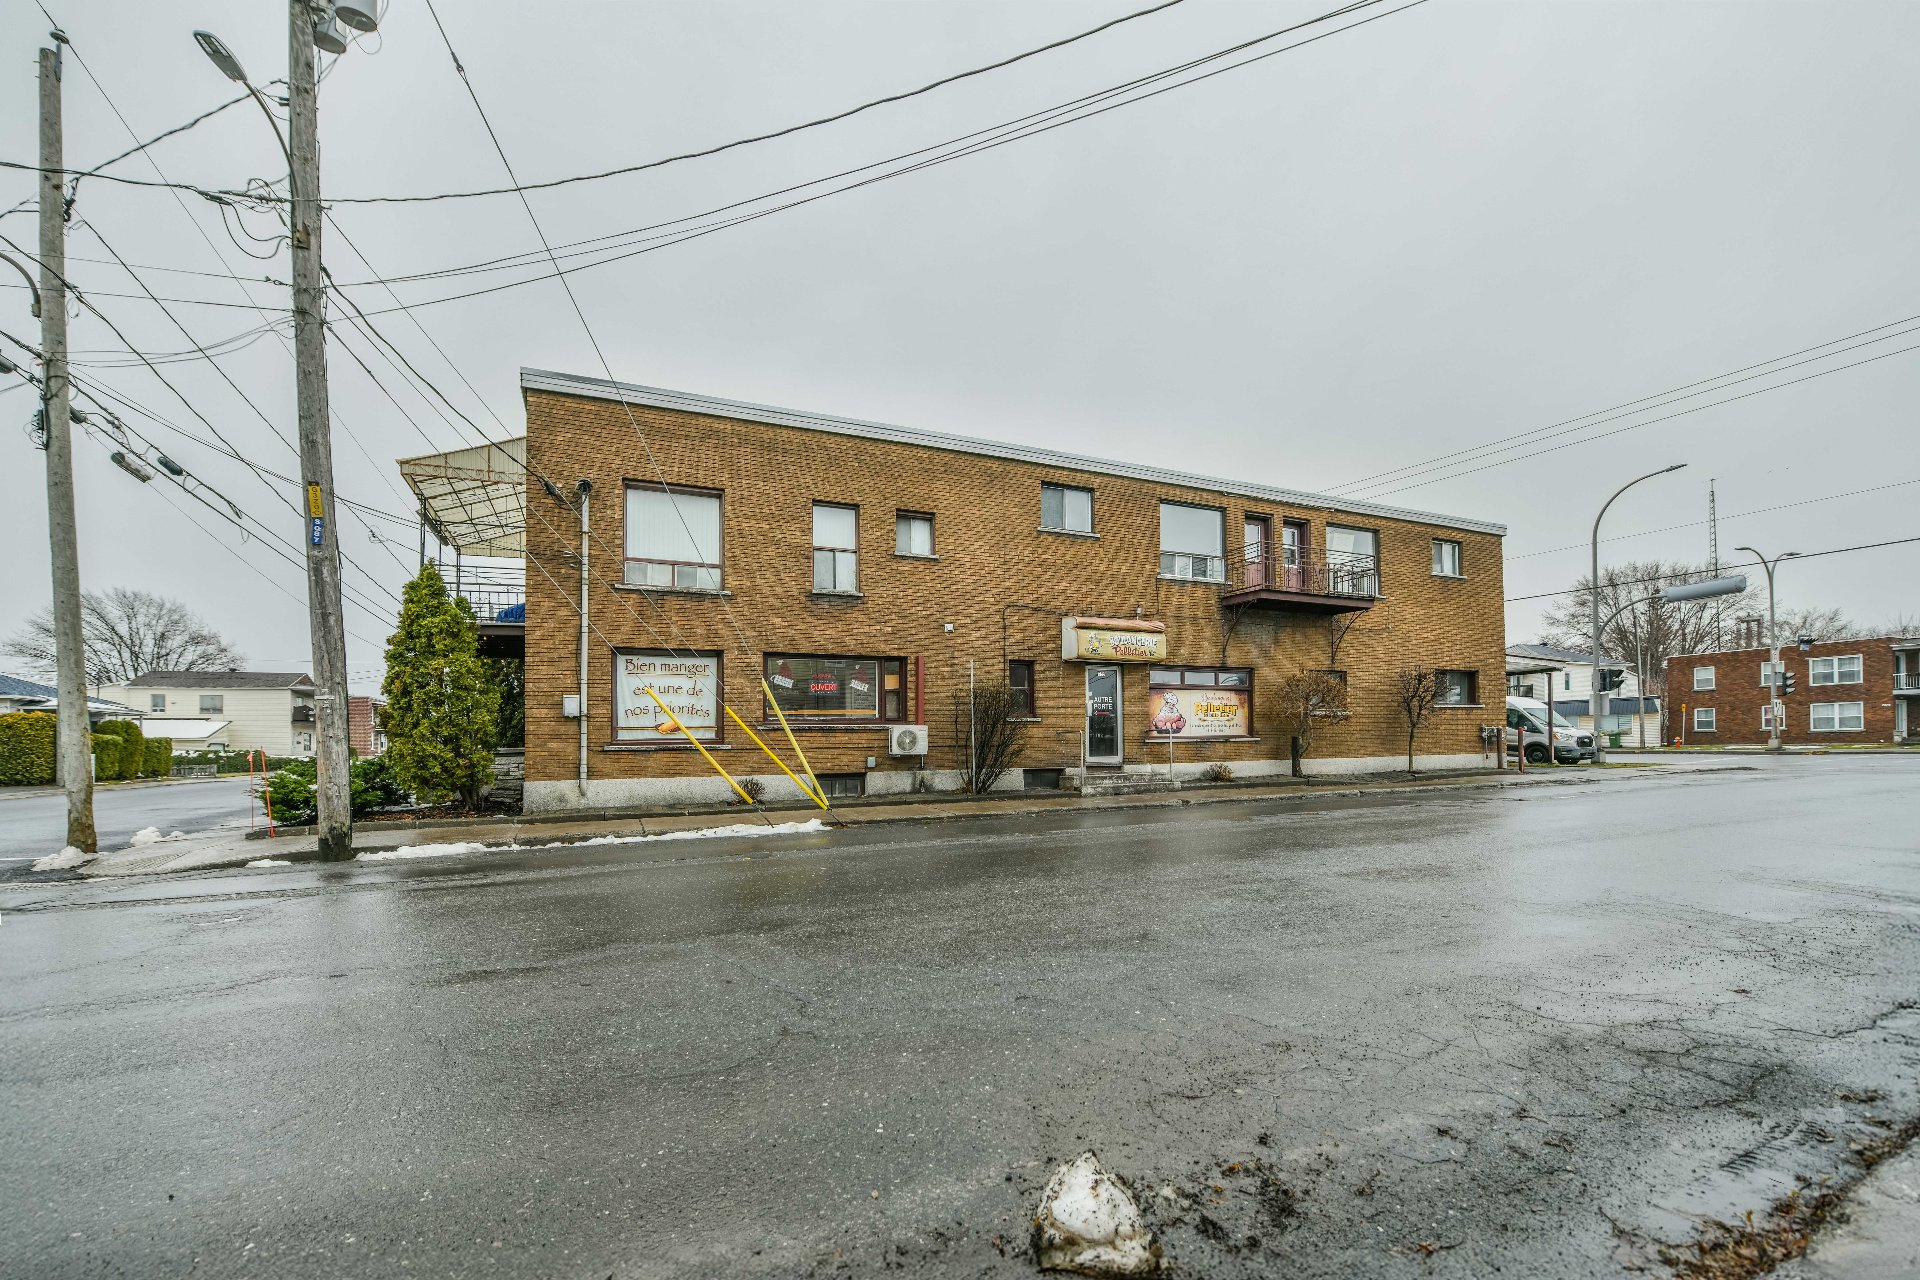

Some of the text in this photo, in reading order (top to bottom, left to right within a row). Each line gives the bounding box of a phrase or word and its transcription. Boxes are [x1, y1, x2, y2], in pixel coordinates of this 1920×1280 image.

[1112, 645, 1149, 657] Pelletier
[625, 657, 710, 679] Bien manger
[658, 684, 683, 695] une
[686, 680, 704, 697] de
[624, 705, 650, 718] nos
[1194, 702, 1239, 717] Pelletier
